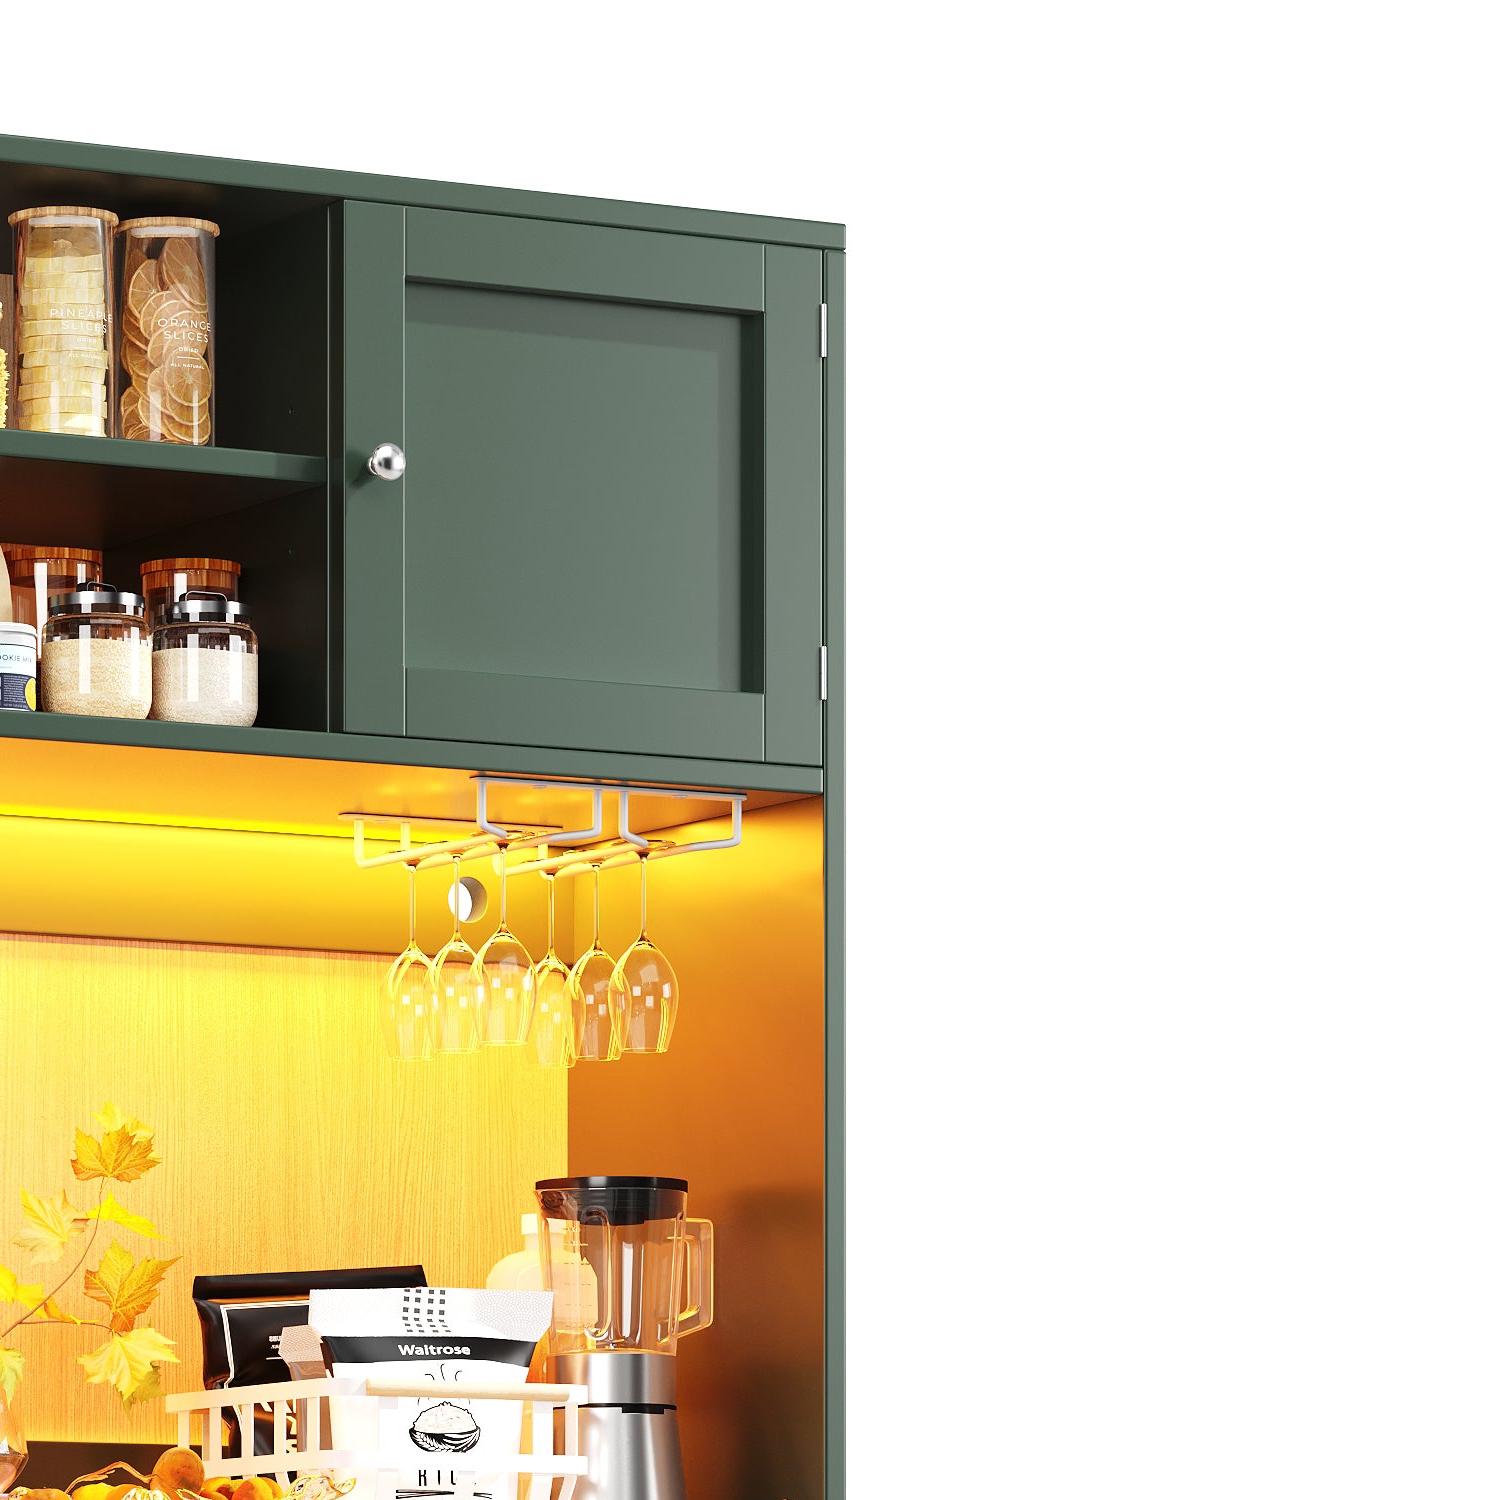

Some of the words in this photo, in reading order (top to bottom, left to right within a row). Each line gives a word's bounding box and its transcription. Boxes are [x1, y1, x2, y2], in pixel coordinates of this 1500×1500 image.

[61, 320, 107, 333] SLICES
[157, 318, 211, 332] ORANGE
[163, 330, 209, 343] SLICES
[398, 1343, 471, 1356] Waitrose
